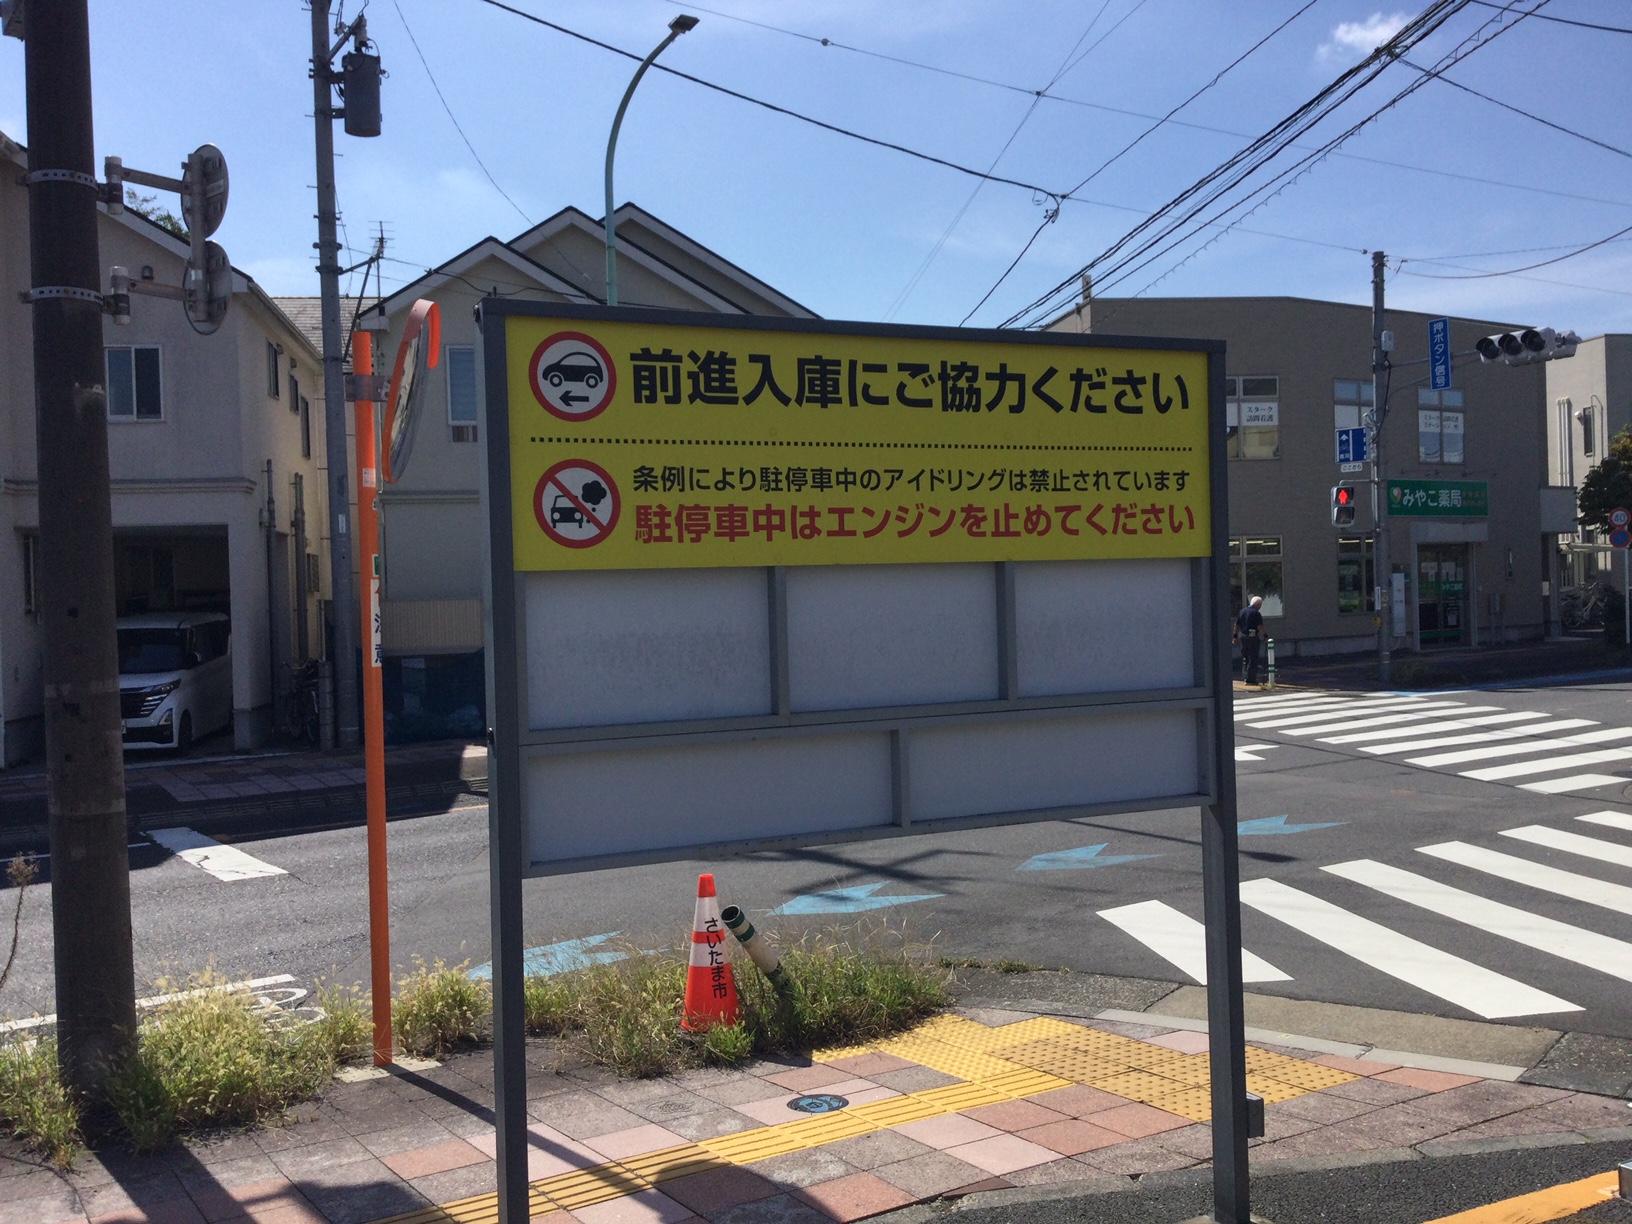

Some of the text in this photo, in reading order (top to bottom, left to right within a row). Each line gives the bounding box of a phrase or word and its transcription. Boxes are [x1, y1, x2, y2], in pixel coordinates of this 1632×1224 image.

[630, 347, 1189, 414] 前進入庫にご協力ください
[1433, 321, 1446, 387] 押ボタン信号
[633, 465, 1190, 493] 条例により駐停車中のアイドリングは禁止されています
[1402, 488, 1462, 508] みやこ薬局
[635, 502, 1195, 544] 駐停車中はエンジンを止めてください
[704, 917, 727, 999] さいたま市
